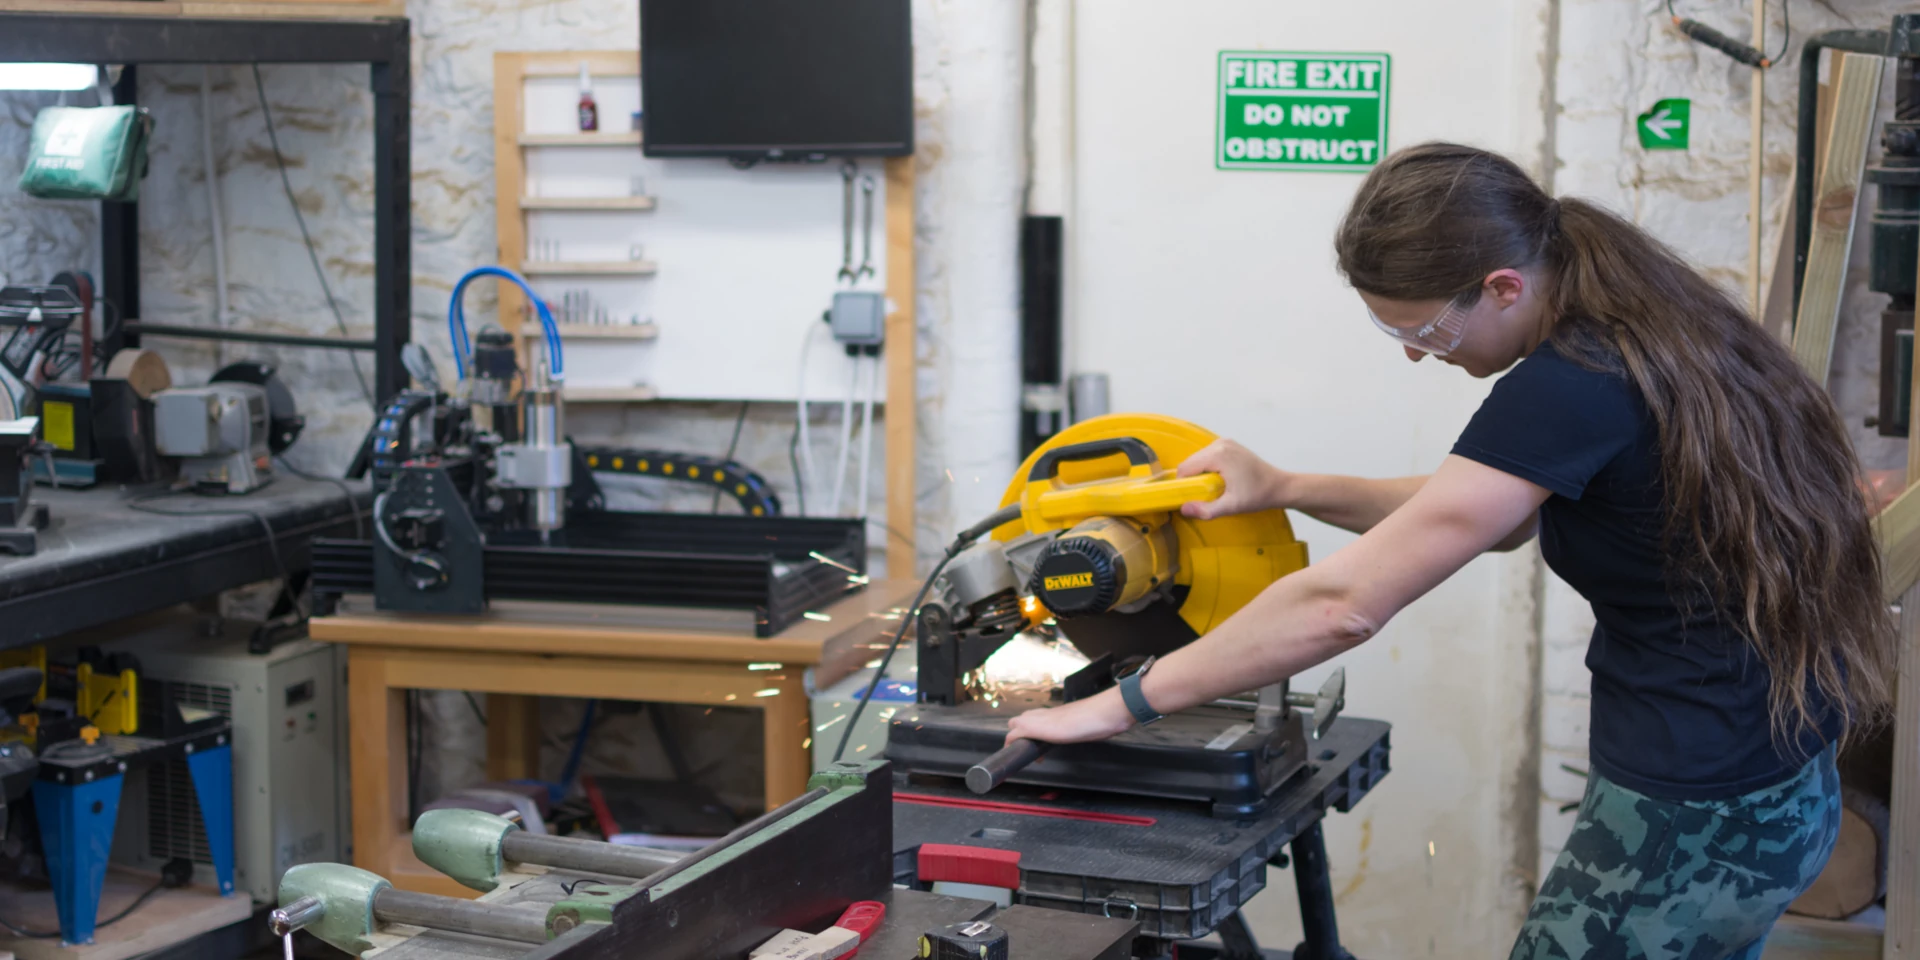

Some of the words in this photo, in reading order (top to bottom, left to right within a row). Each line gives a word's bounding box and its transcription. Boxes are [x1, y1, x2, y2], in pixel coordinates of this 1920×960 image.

[1227, 60, 1297, 88] FIRE
[1305, 62, 1380, 89] EXIT
[1244, 103, 1284, 126] DO
[1291, 104, 1350, 127] NOT
[1225, 136, 1377, 162] OBSTRUCT
[35, 157, 65, 169] FIRST
[64, 158, 84, 170] AID
